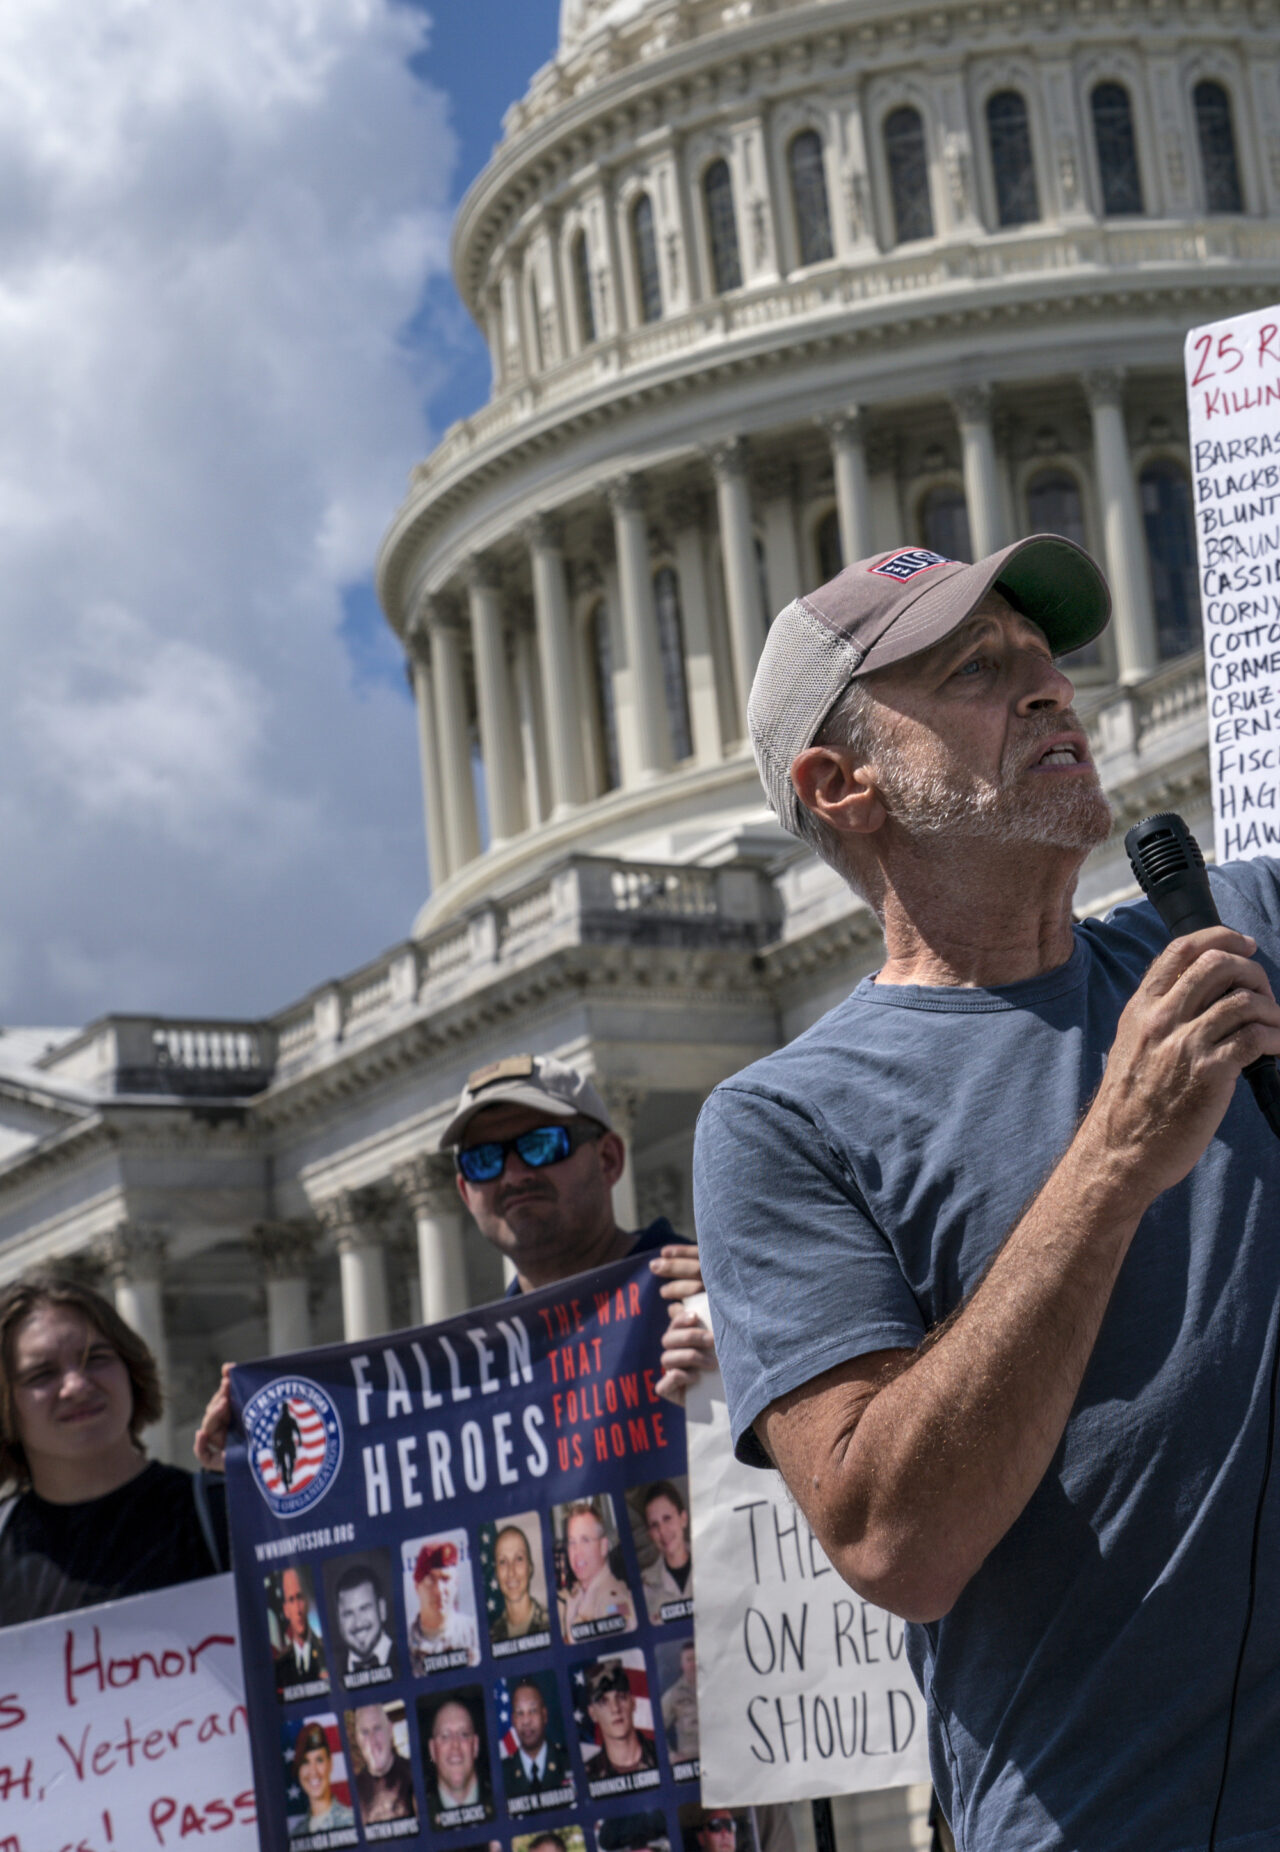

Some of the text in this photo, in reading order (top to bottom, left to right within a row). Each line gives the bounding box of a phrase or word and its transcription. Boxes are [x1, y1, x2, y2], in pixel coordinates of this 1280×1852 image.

[1192, 333, 1244, 387] 25
[350, 1282, 641, 1427] FALLEN THE WAR
[547, 1337, 602, 1385] THAT
[362, 1367, 667, 1518] HEROES FOLLOWE
[557, 1412, 668, 1472] US HOME
[61, 1624, 236, 1707] Honor
[743, 1602, 808, 1675] ON
[56, 1704, 249, 1782] Veteran
[746, 1689, 916, 1765] SHOULD
[149, 1790, 258, 1847] PASS
